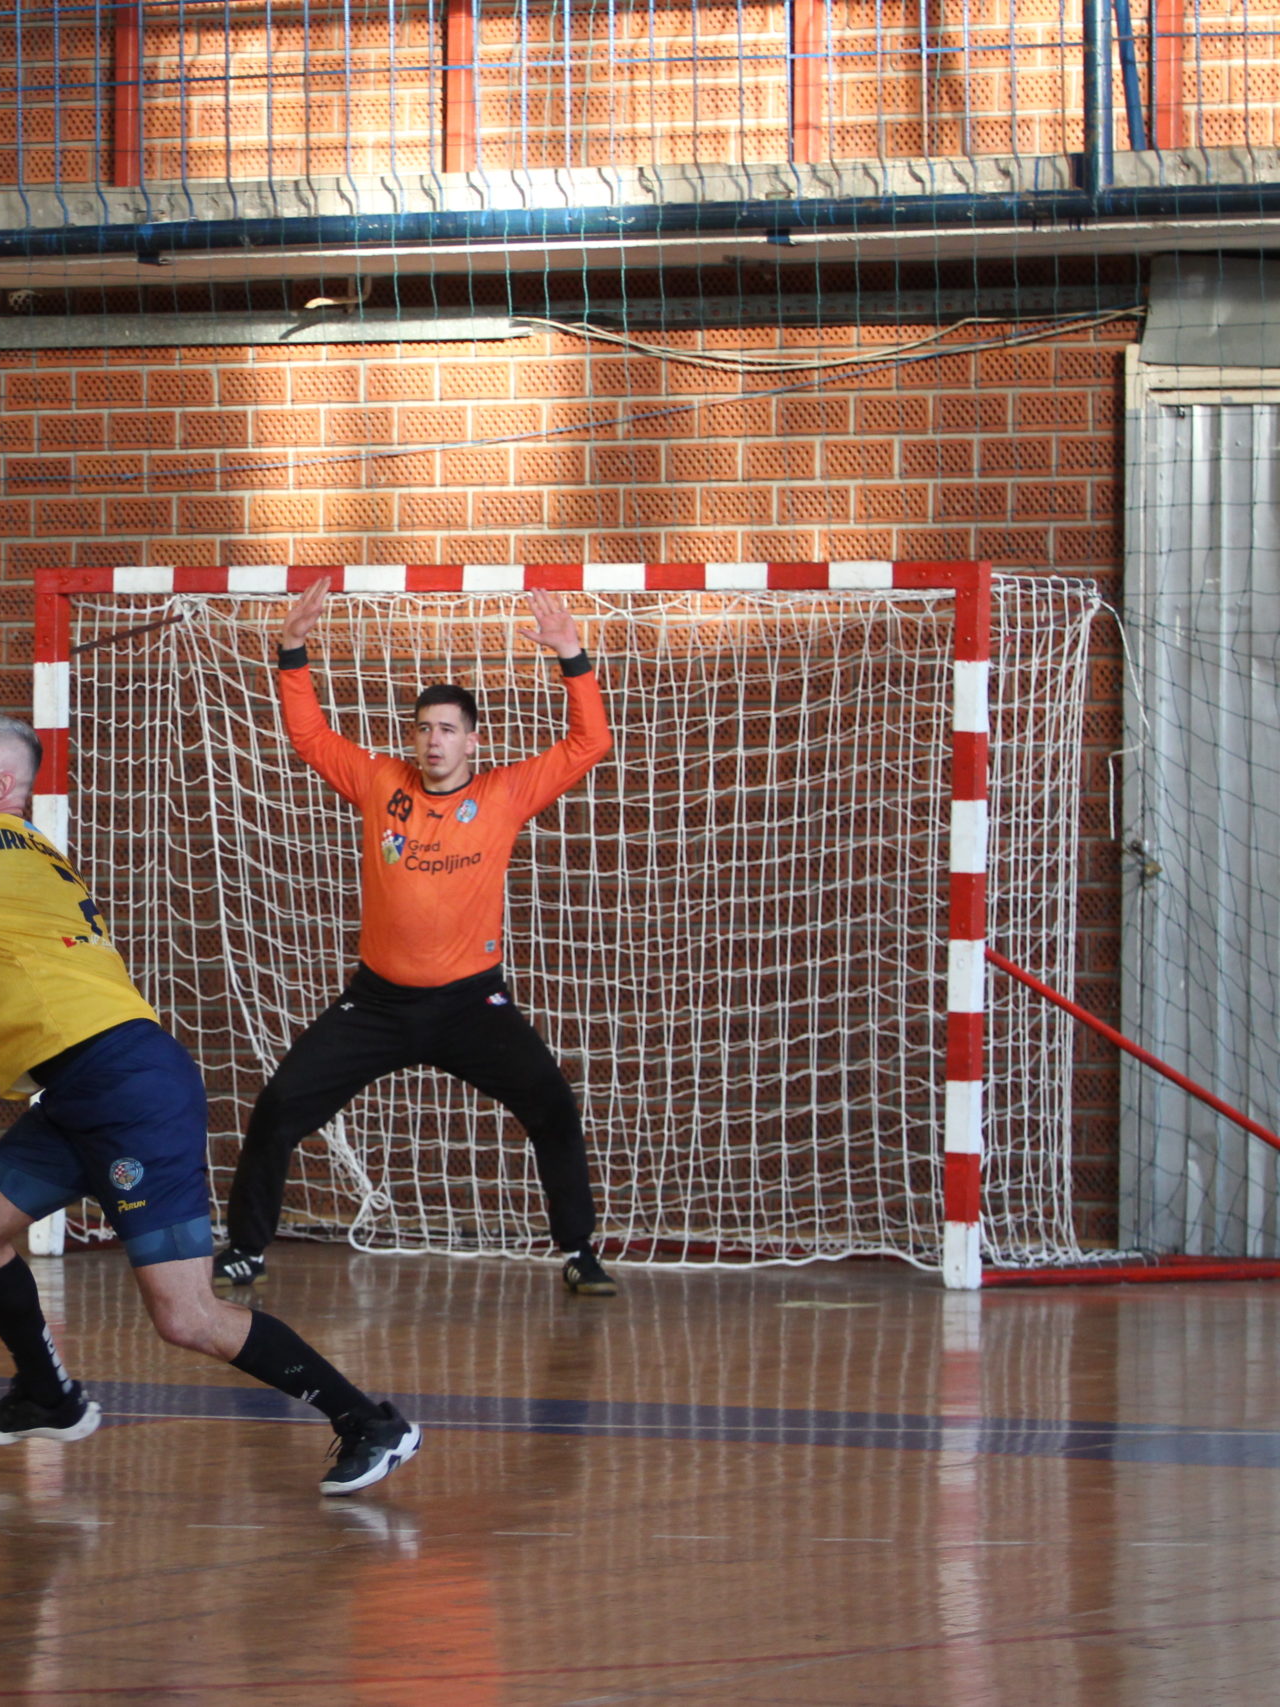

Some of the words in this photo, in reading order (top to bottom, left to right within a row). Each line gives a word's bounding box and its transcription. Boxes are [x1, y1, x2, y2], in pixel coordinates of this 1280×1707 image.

[387, 788, 413, 822] 89
[407, 839, 441, 852] Grad
[404, 852, 482, 875] Čapljina
